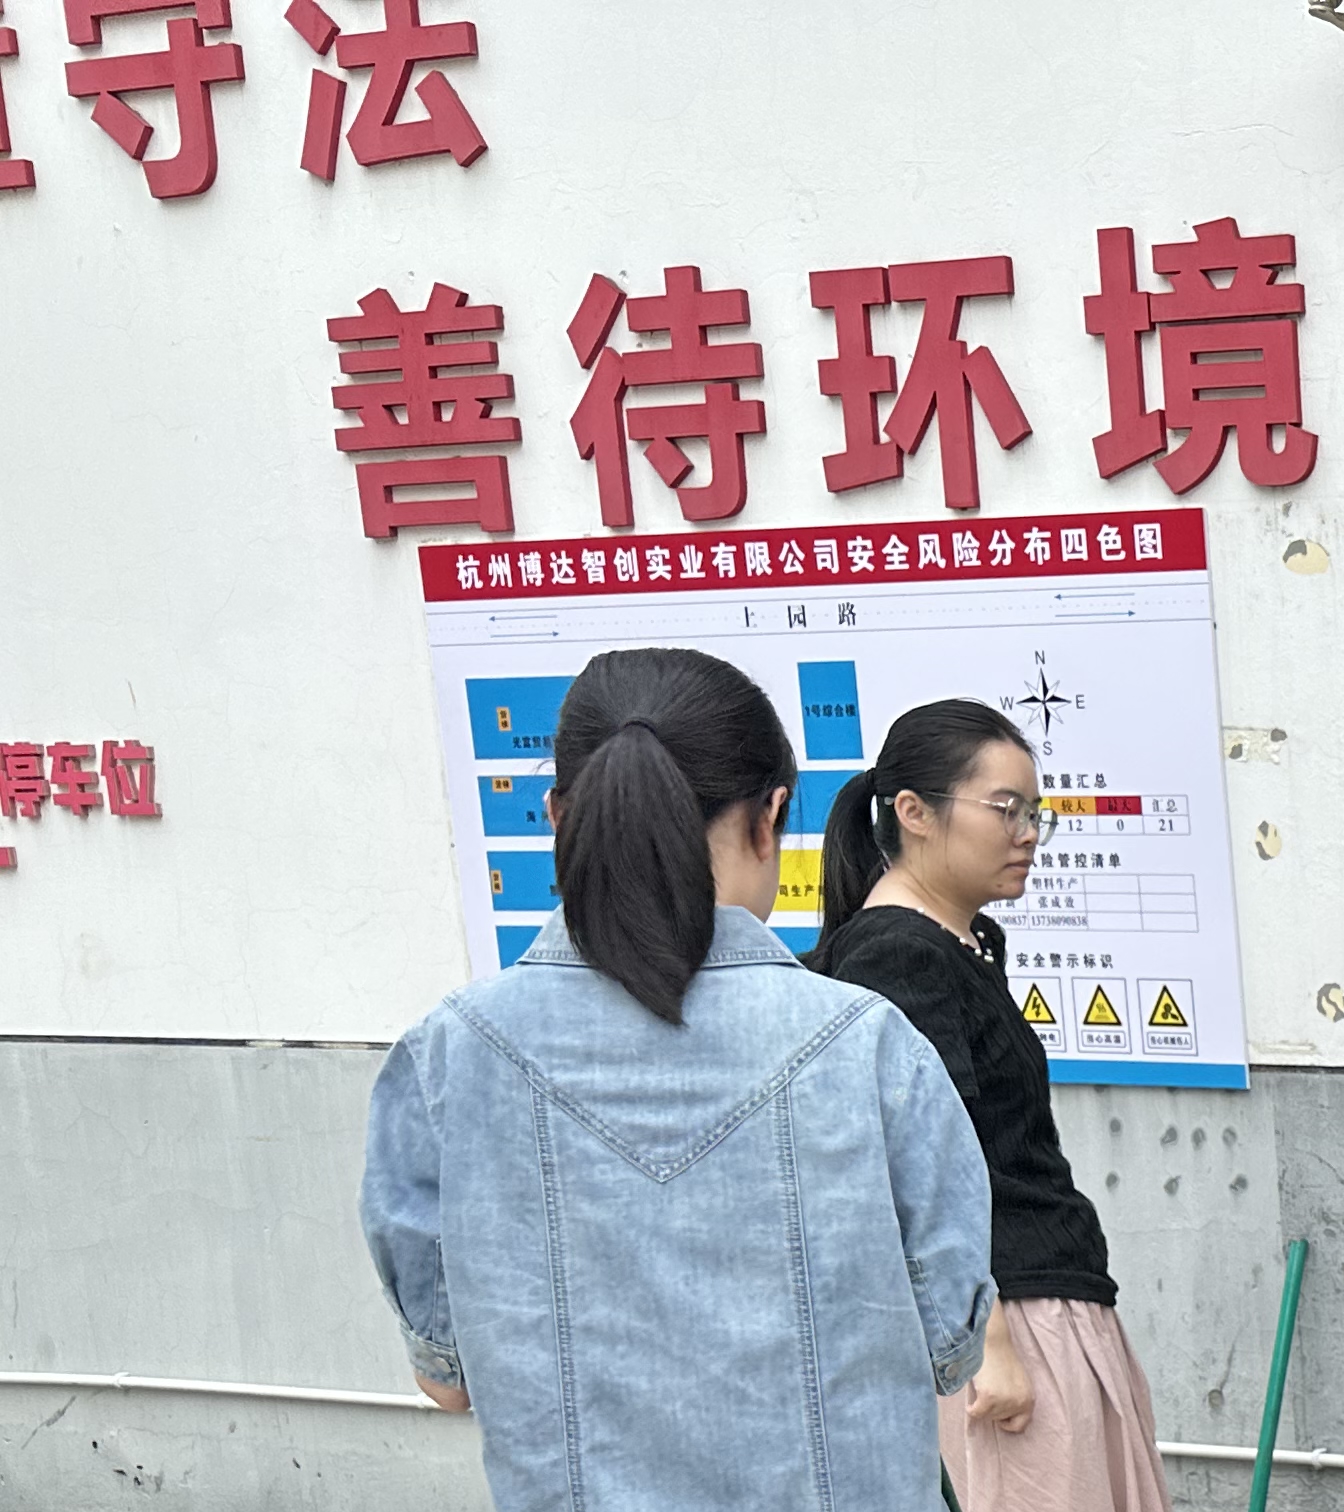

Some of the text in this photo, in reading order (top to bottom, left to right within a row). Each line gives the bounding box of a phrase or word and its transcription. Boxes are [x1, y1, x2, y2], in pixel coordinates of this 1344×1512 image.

[0, 0, 487, 200] 守法
[327, 215, 1320, 539] 善待环境
[456, 522, 1165, 590] 杭州博达智创实业有限公司安全风险分布四色图
[1035, 650, 1046, 665] N
[1000, 696, 1014, 711] W
[1075, 695, 1086, 710] E
[1042, 742, 1053, 756] S
[0, 739, 162, 818] 停车位
[1042, 773, 1107, 789] 数量汇总
[1067, 818, 1084, 832] 12
[1116, 818, 1125, 832] 0
[1158, 818, 1174, 832] 21
[1032, 852, 1122, 869] 险管控清单
[1016, 952, 1114, 969] 安全警示标识
